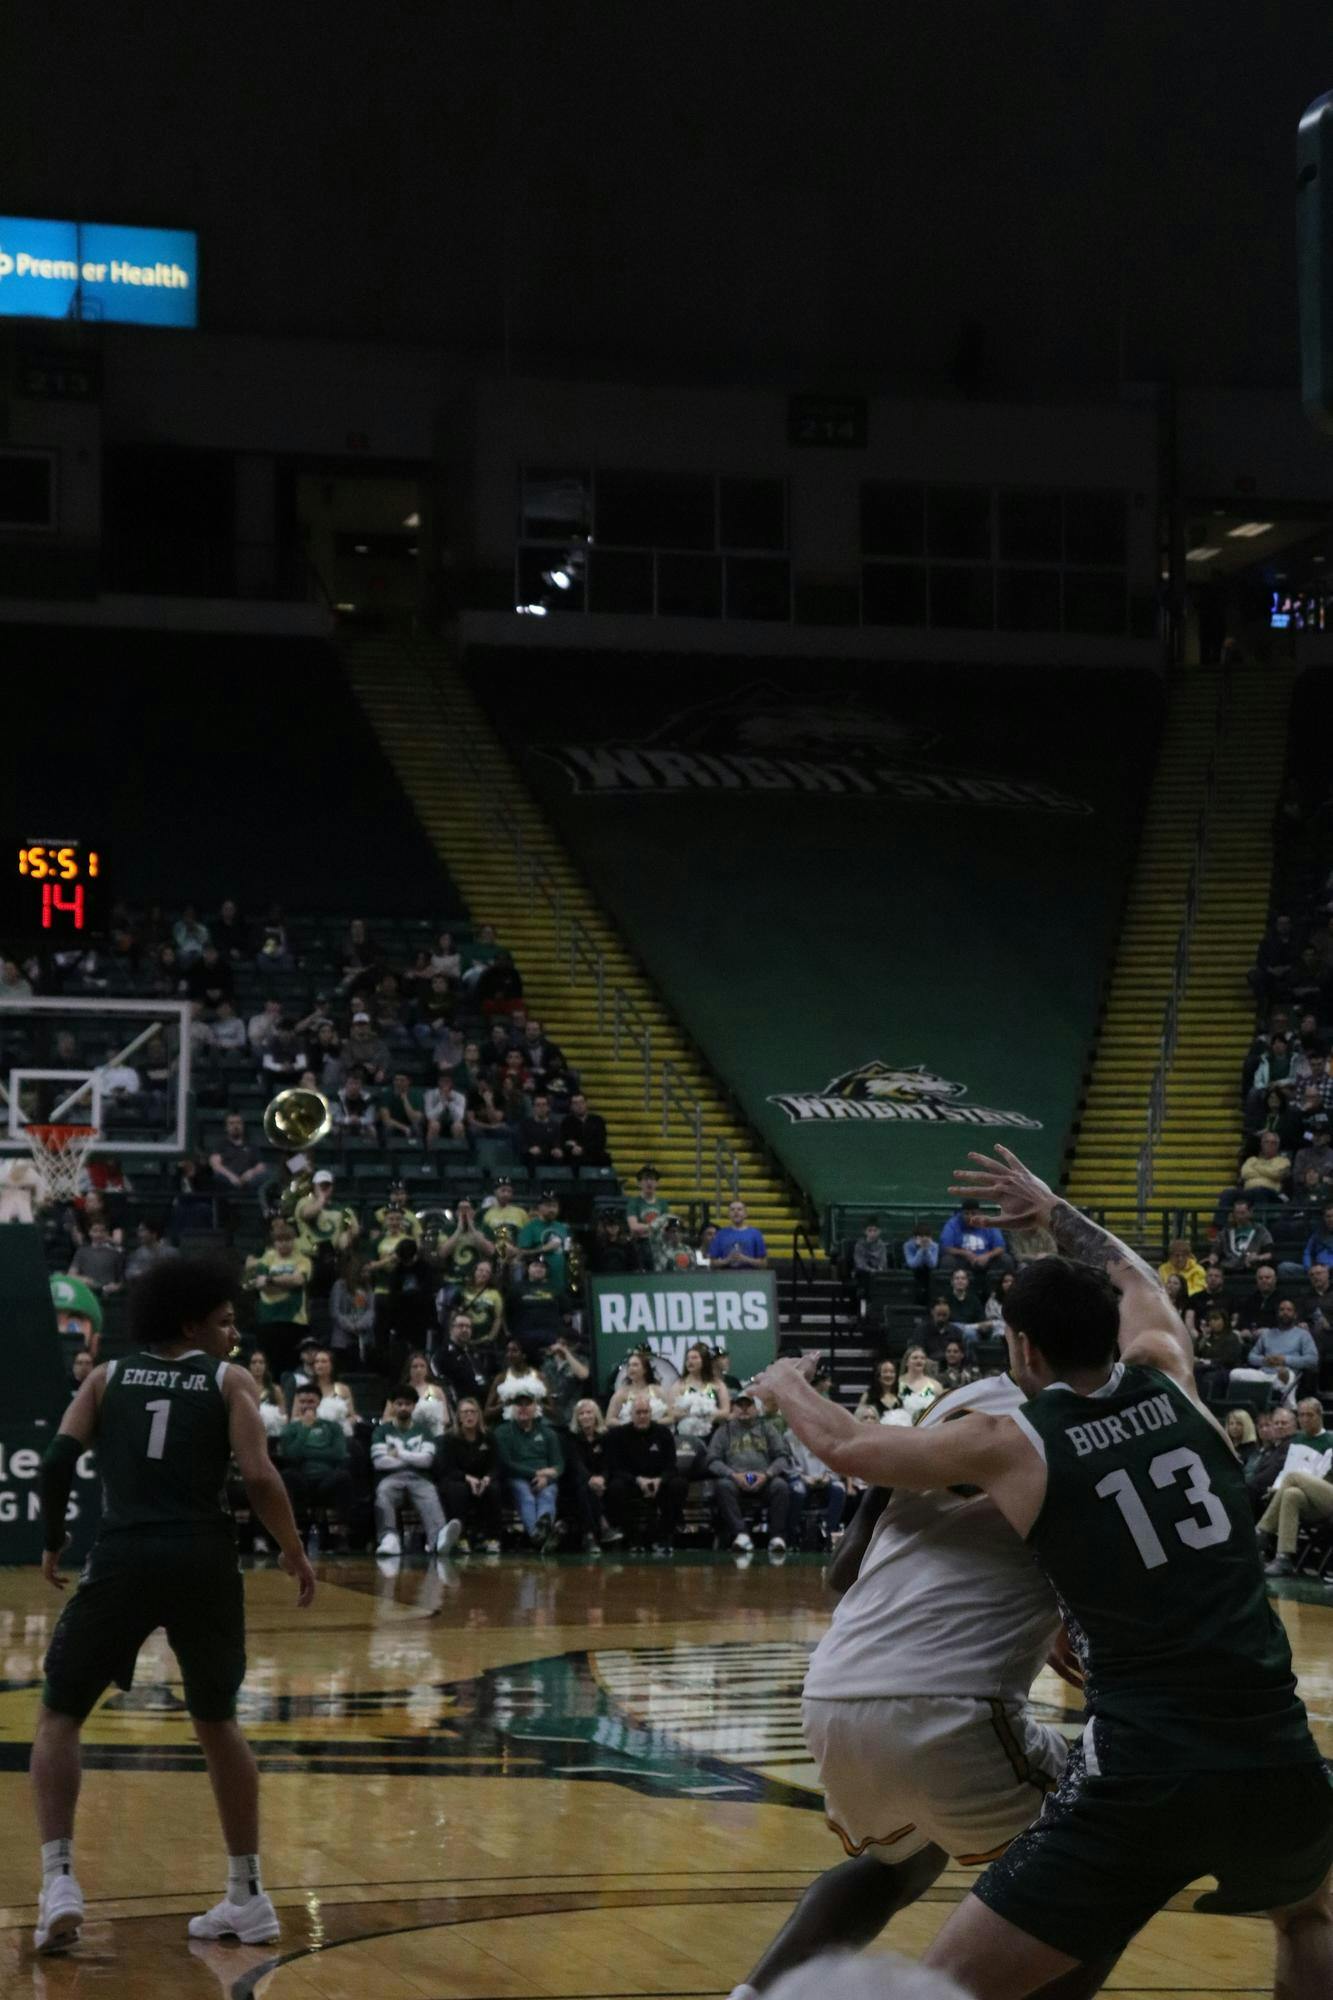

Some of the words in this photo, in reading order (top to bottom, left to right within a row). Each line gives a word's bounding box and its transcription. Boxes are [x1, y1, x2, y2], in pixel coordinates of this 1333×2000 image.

[16, 252, 107, 283] Premer
[110, 259, 190, 289] Health
[561, 747, 880, 794] WRIGHT
[19, 847, 98, 879] 15:51
[42, 883, 84, 928] 14
[788, 1096, 939, 1121] WRIGHT
[598, 1291, 769, 1333] RAIDERS
[120, 1368, 182, 1389] EMERY
[181, 1373, 209, 1392] JR.
[144, 1398, 172, 1460] 1
[1064, 1392, 1178, 1456] BURTON
[1094, 1446, 1232, 1569] 13
